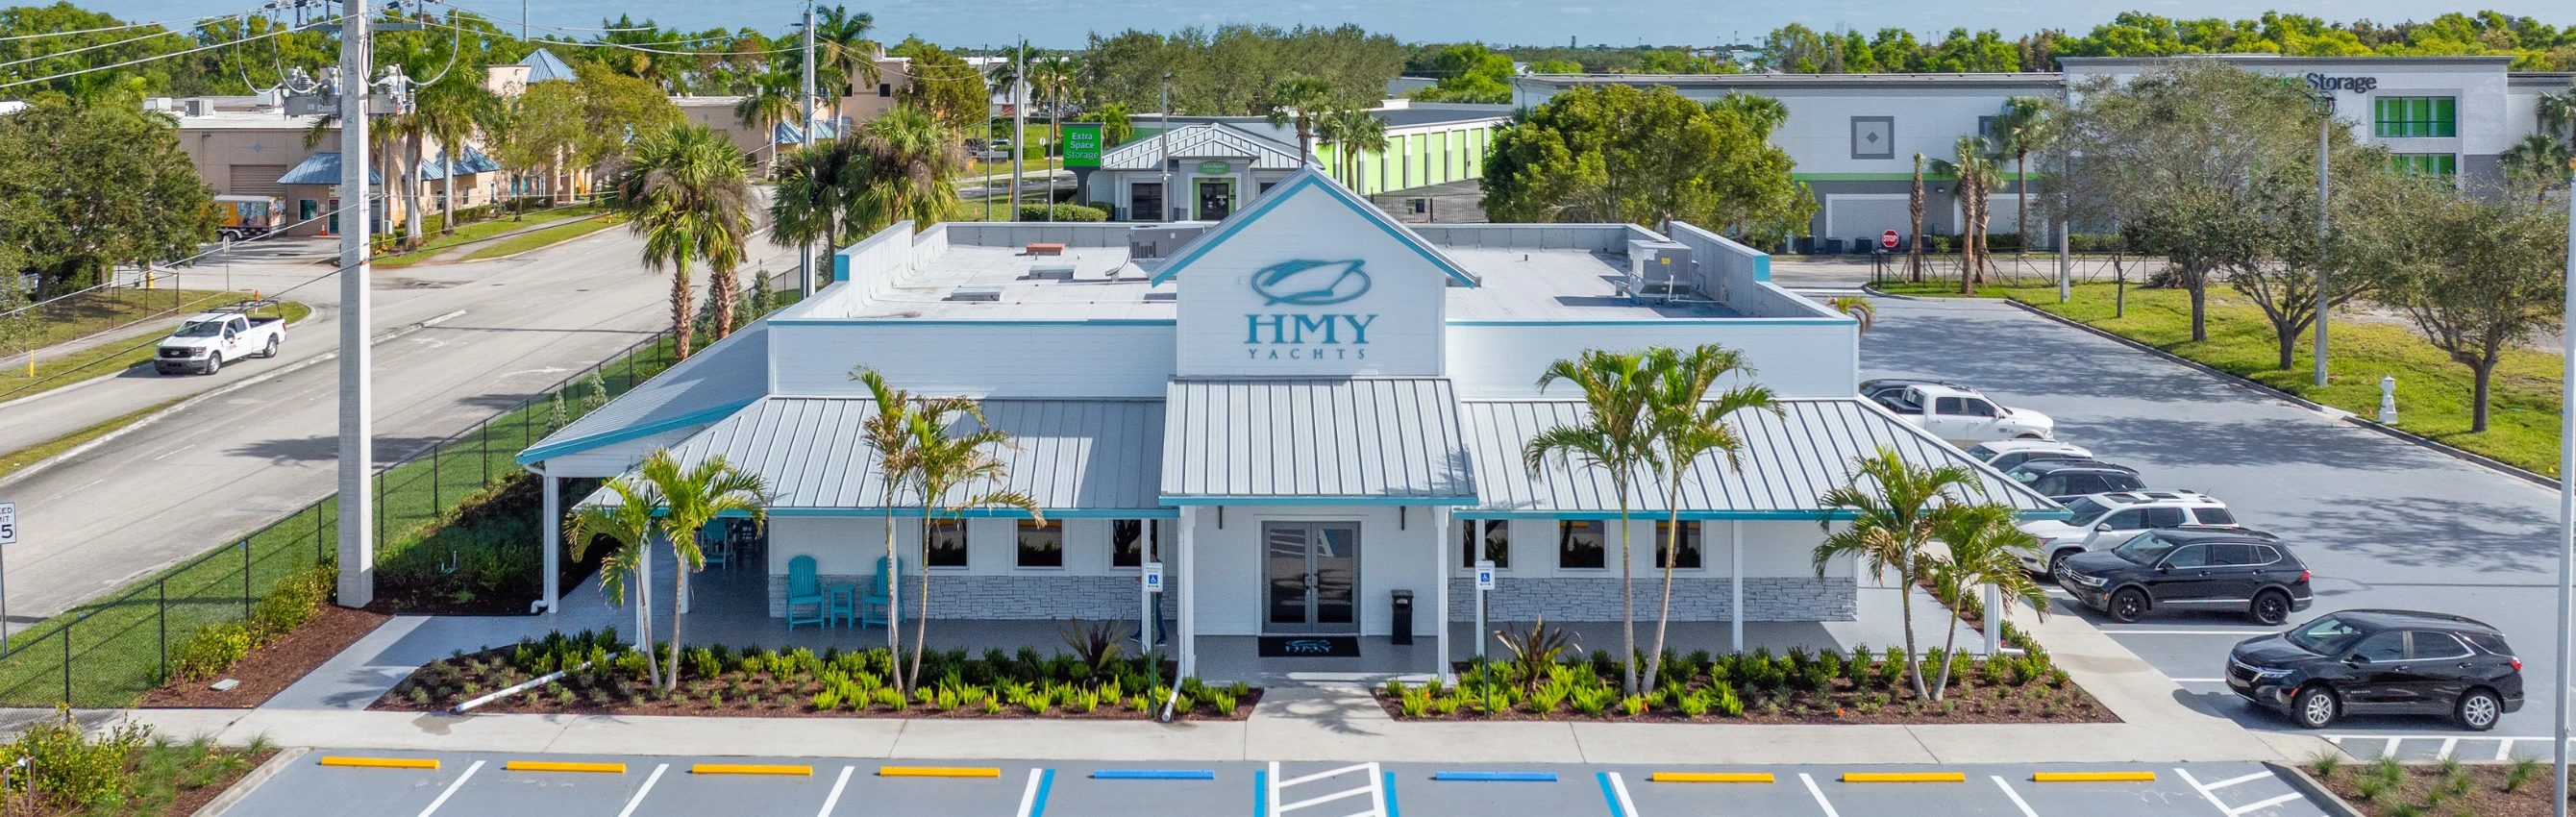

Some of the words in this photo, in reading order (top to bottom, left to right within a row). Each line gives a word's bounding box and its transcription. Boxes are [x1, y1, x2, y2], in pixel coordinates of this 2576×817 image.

[2307, 73, 2377, 93] Storage
[1070, 141, 1095, 150] Space
[1066, 151, 1099, 160] Storage
[1244, 314, 1378, 344] HMY
[1249, 349, 1365, 359] YACHTS
